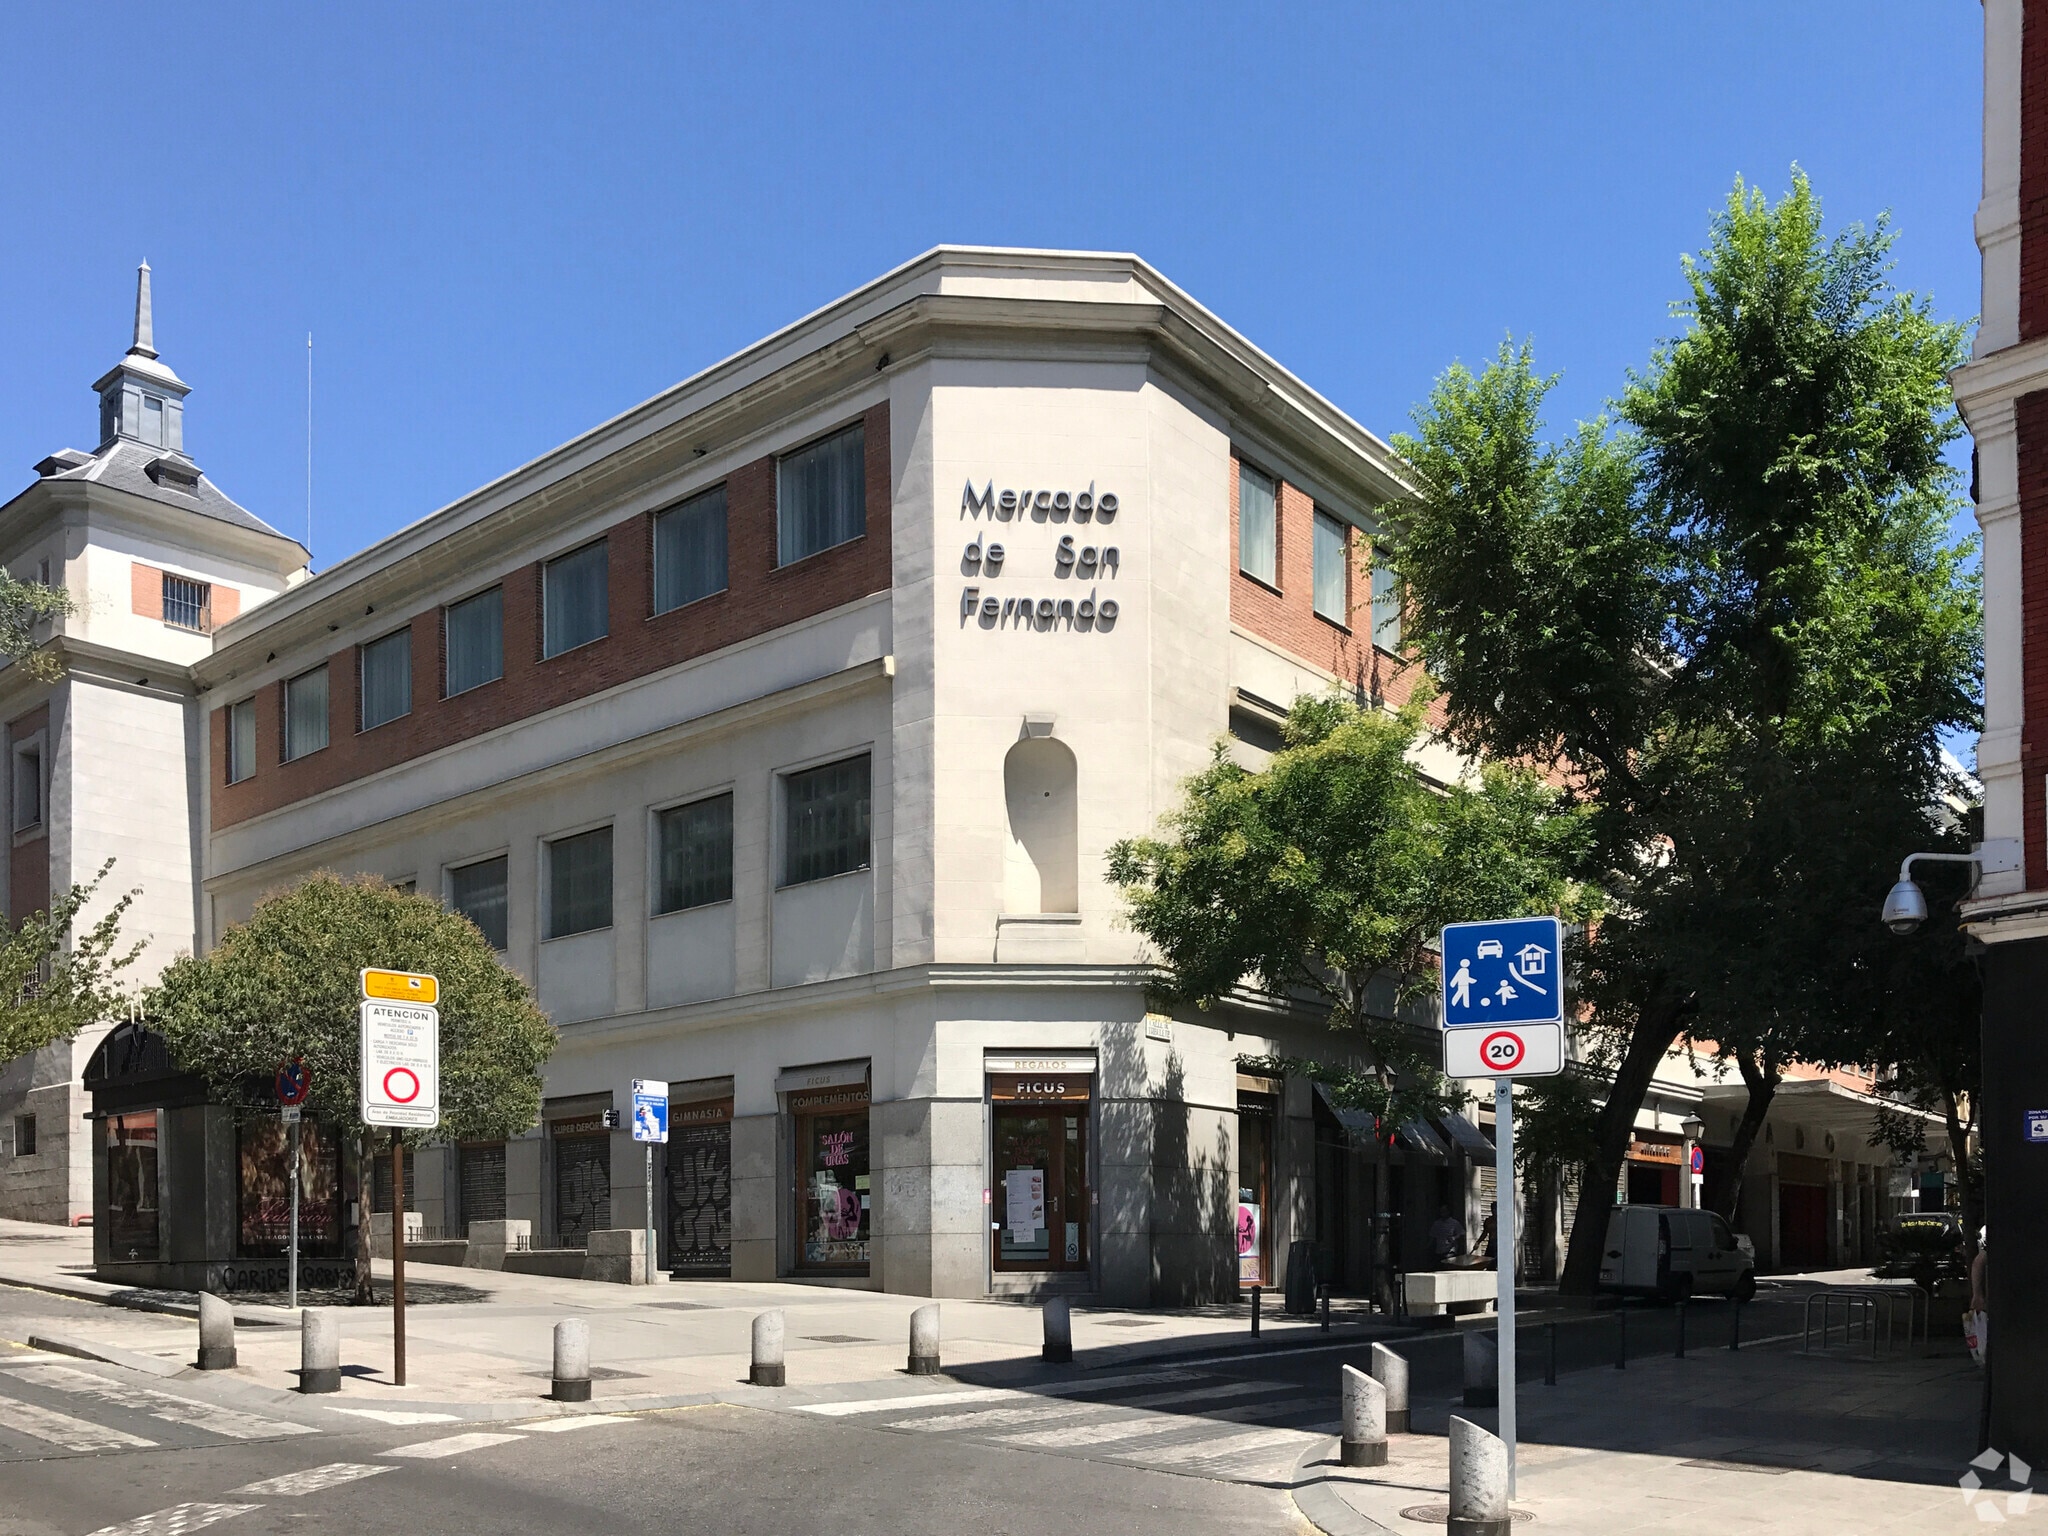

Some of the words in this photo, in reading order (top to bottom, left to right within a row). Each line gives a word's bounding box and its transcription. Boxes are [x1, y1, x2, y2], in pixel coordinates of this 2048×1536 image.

[962, 478, 1119, 514] Mercado
[964, 531, 1005, 563] de
[1056, 534, 1120, 567] San
[961, 586, 1119, 620] Fernando
[373, 1008, 429, 1021] ATENCIÓN
[1490, 1044, 1515, 1058] 20
[1015, 1061, 1067, 1069] REGALOS
[807, 1076, 831, 1086] FICUS
[1017, 1082, 1065, 1094] FICUS
[792, 1090, 869, 1108] COMPLEMENTOS
[673, 1108, 723, 1122] GIMNASIA
[553, 1124, 576, 1134] SUPER
[822, 1130, 854, 1145] SALÓN
[830, 1143, 844, 1155] DE
